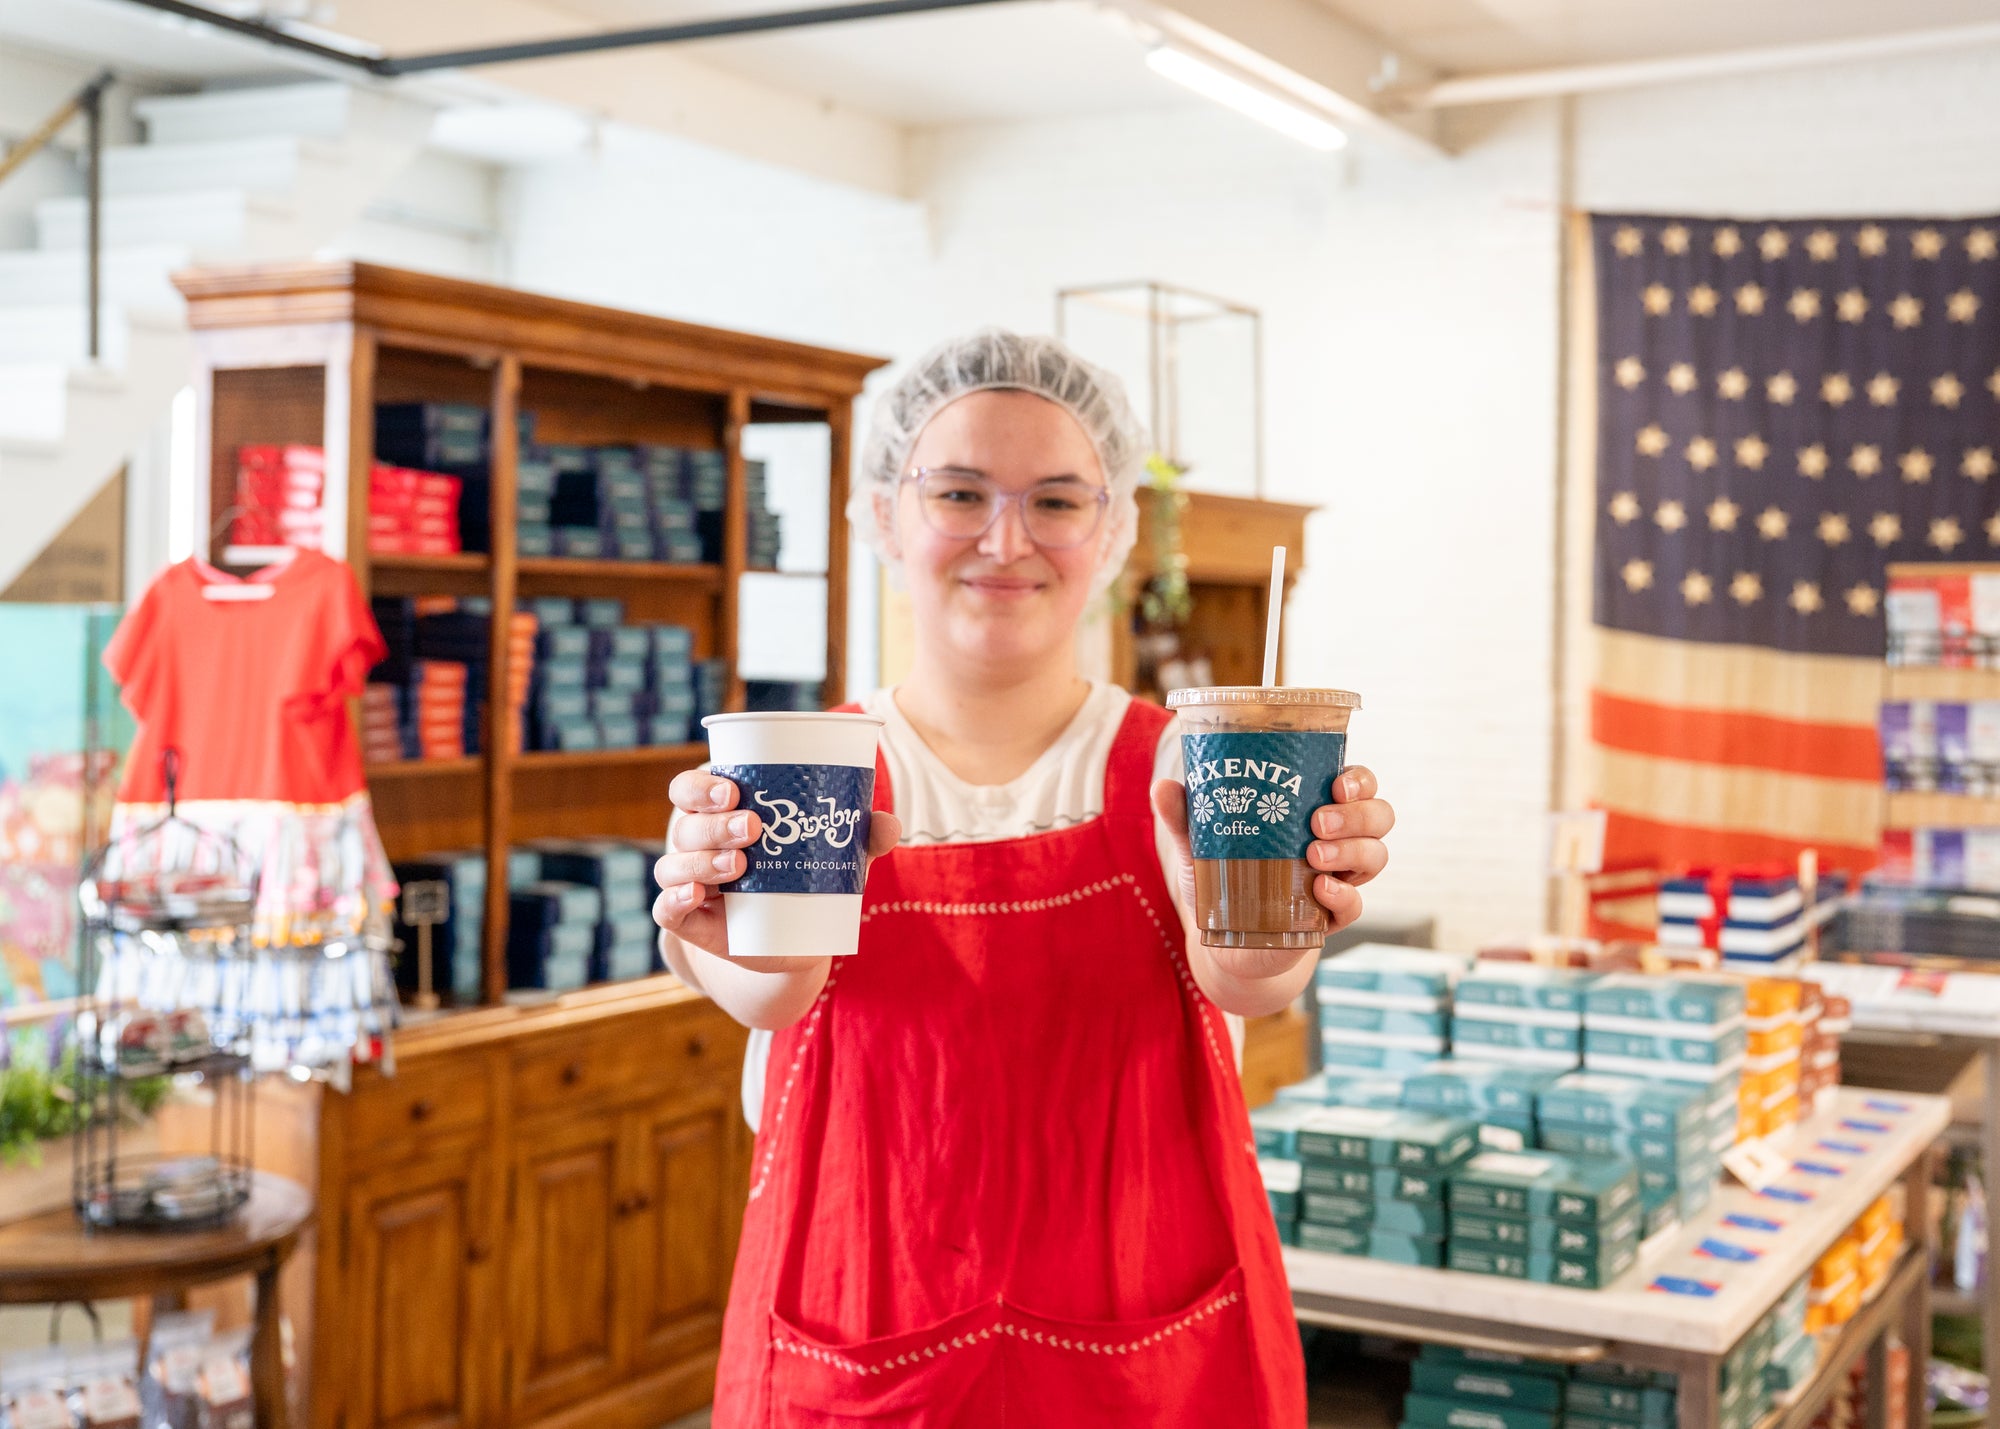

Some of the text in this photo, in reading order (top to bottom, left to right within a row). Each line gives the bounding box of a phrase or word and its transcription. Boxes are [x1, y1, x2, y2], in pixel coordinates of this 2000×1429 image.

[1186, 758, 1302, 797] BIXENTA
[754, 789, 861, 856] Bixby
[1213, 820, 1260, 836] Coffee
[755, 860, 857, 871] BIXBY CHOCOLATE
